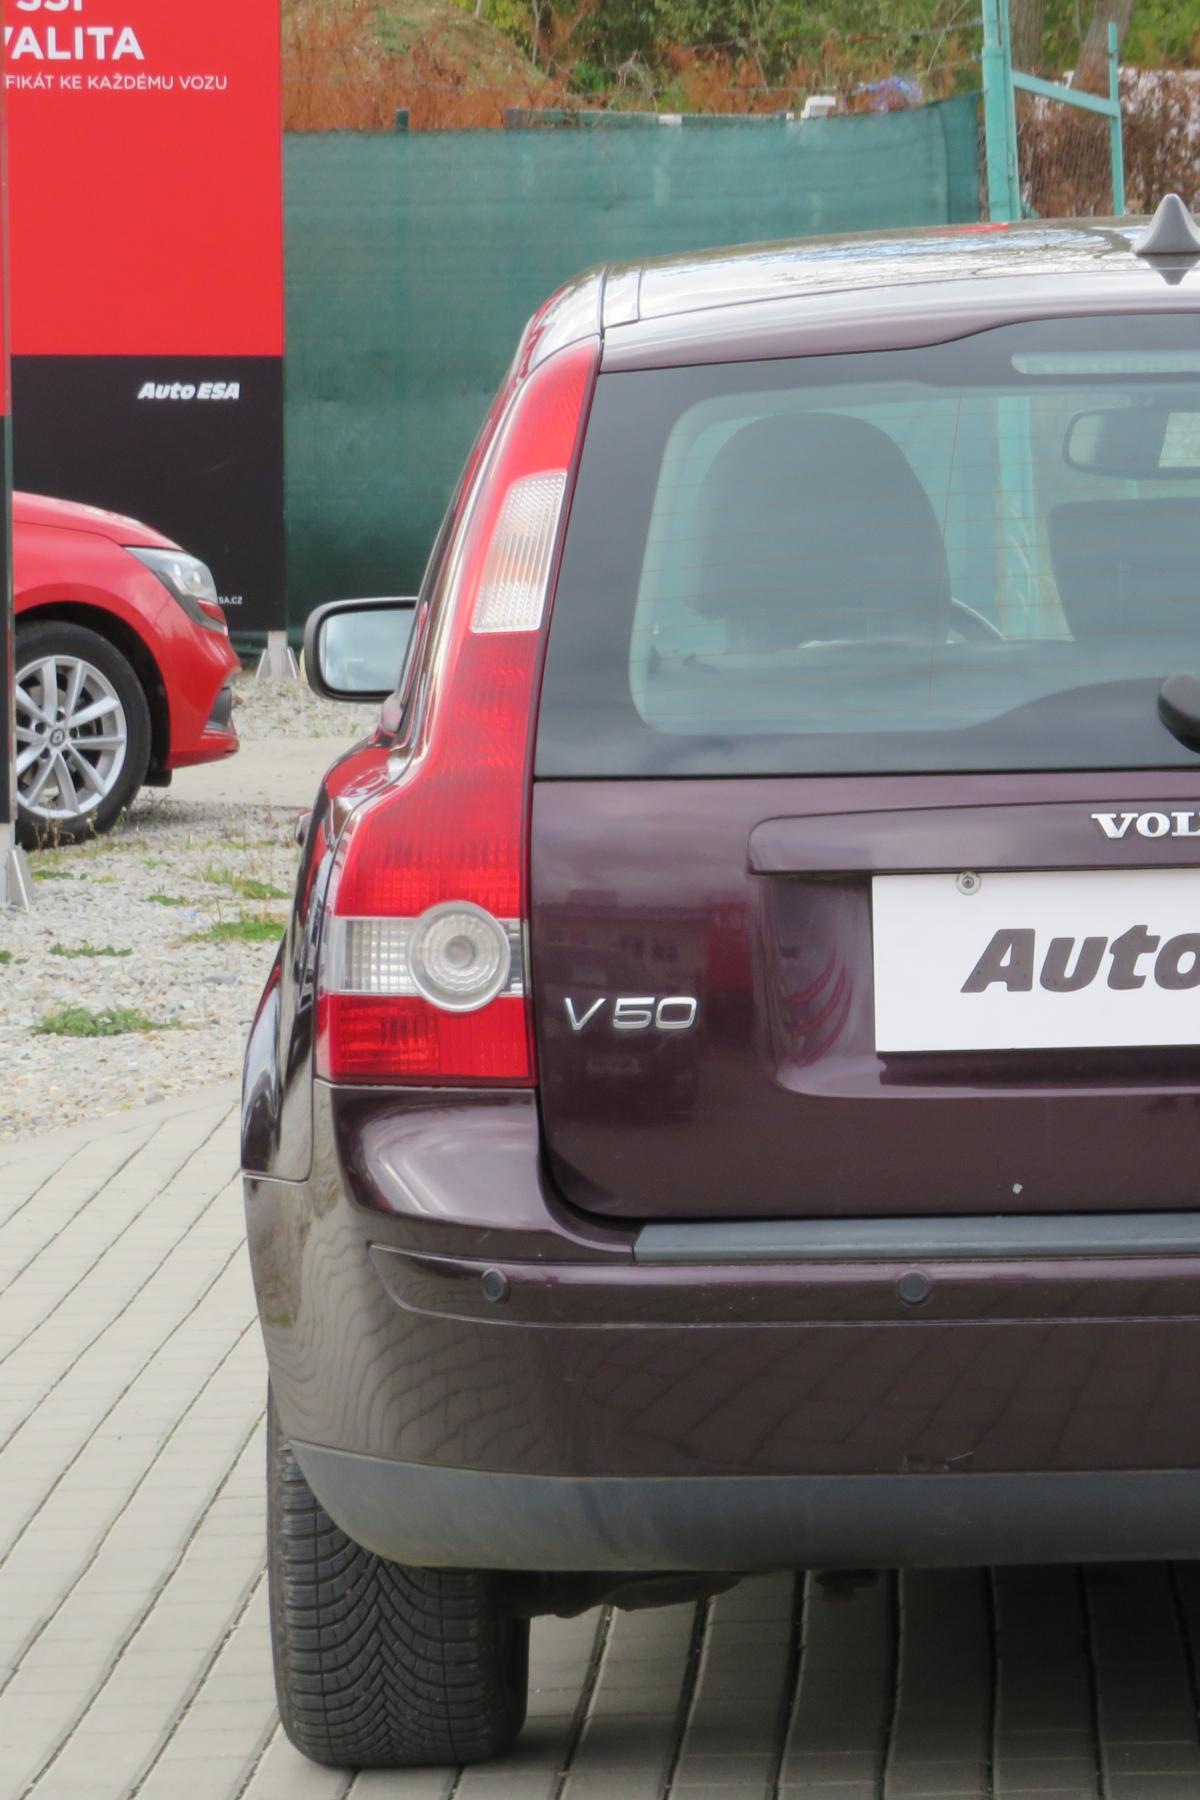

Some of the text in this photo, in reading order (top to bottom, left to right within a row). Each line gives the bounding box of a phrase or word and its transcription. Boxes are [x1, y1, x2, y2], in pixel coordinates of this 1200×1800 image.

[60, 75, 82, 89] KE
[88, 73, 174, 90] KAŽDÉMU
[179, 76, 228, 90] VOZU
[137, 382, 240, 400] Auto ESA
